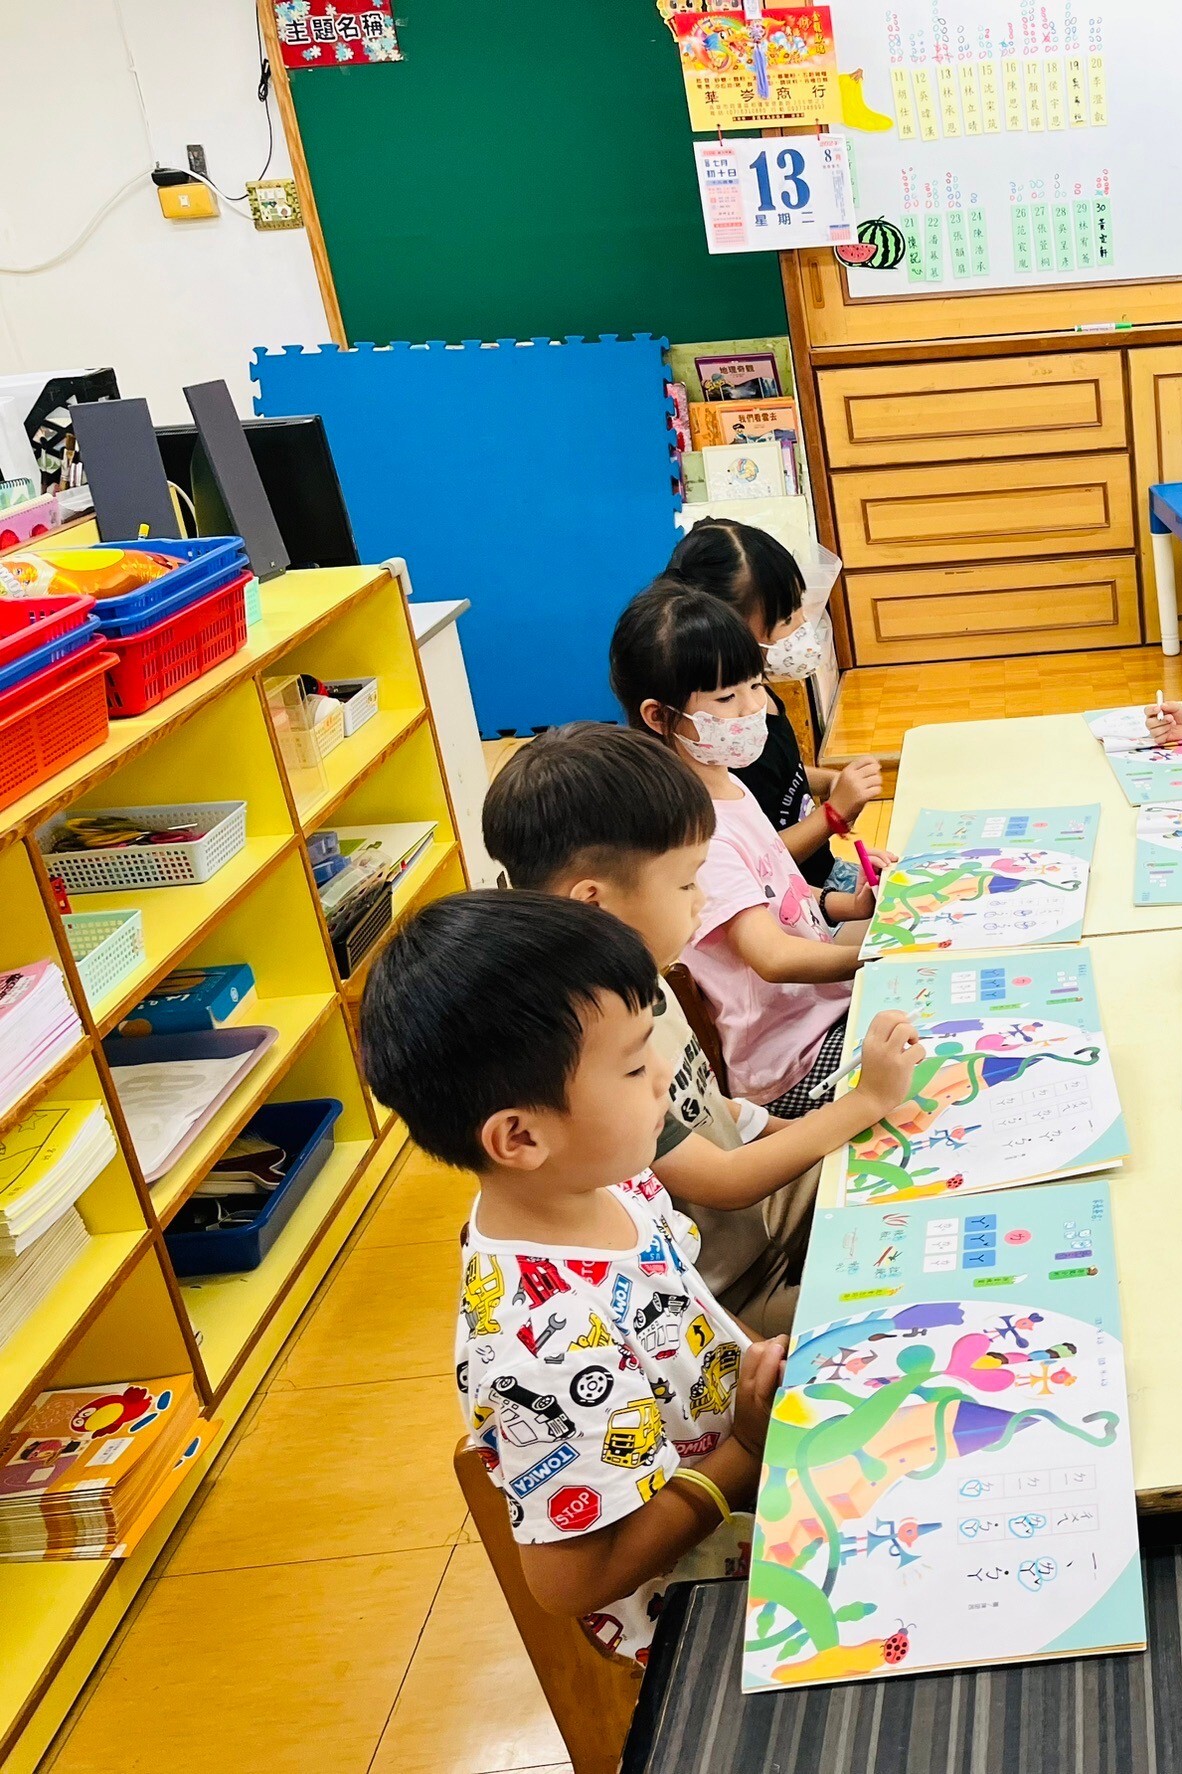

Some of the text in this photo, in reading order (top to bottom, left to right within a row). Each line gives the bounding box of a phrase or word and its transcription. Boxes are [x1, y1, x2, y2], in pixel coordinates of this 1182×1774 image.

[285, 12, 385, 44] 主題名稱
[1006, 63, 1016, 73] 16
[1047, 63, 1057, 73] 18
[1070, 61, 1079, 71] 19
[1091, 58, 1102, 69] 20
[963, 68, 973, 78] 14
[982, 65, 993, 76] 15
[1027, 64, 1037, 74] 17
[894, 72, 904, 81] 11
[915, 73, 926, 84] 12
[940, 70, 951, 80] 13
[824, 149, 832, 162] 8
[707, 169, 737, 178] 初十日
[750, 149, 810, 211] 13
[1035, 207, 1045, 216] 27
[1056, 208, 1066, 217] 28
[1077, 204, 1087, 214] 29
[1096, 203, 1106, 212] 30
[971, 212, 982, 221] 24
[1016, 209, 1026, 218] 26
[755, 211, 815, 227] 星期二
[905, 218, 914, 227] 21
[928, 218, 939, 227] 22
[951, 214, 961, 224] 23
[719, 365, 755, 374] 地理奇觀
[738, 412, 777, 423] 我們看雲去
[513, 1447, 574, 1495] TOMICA
[556, 1490, 591, 1526] STOP
